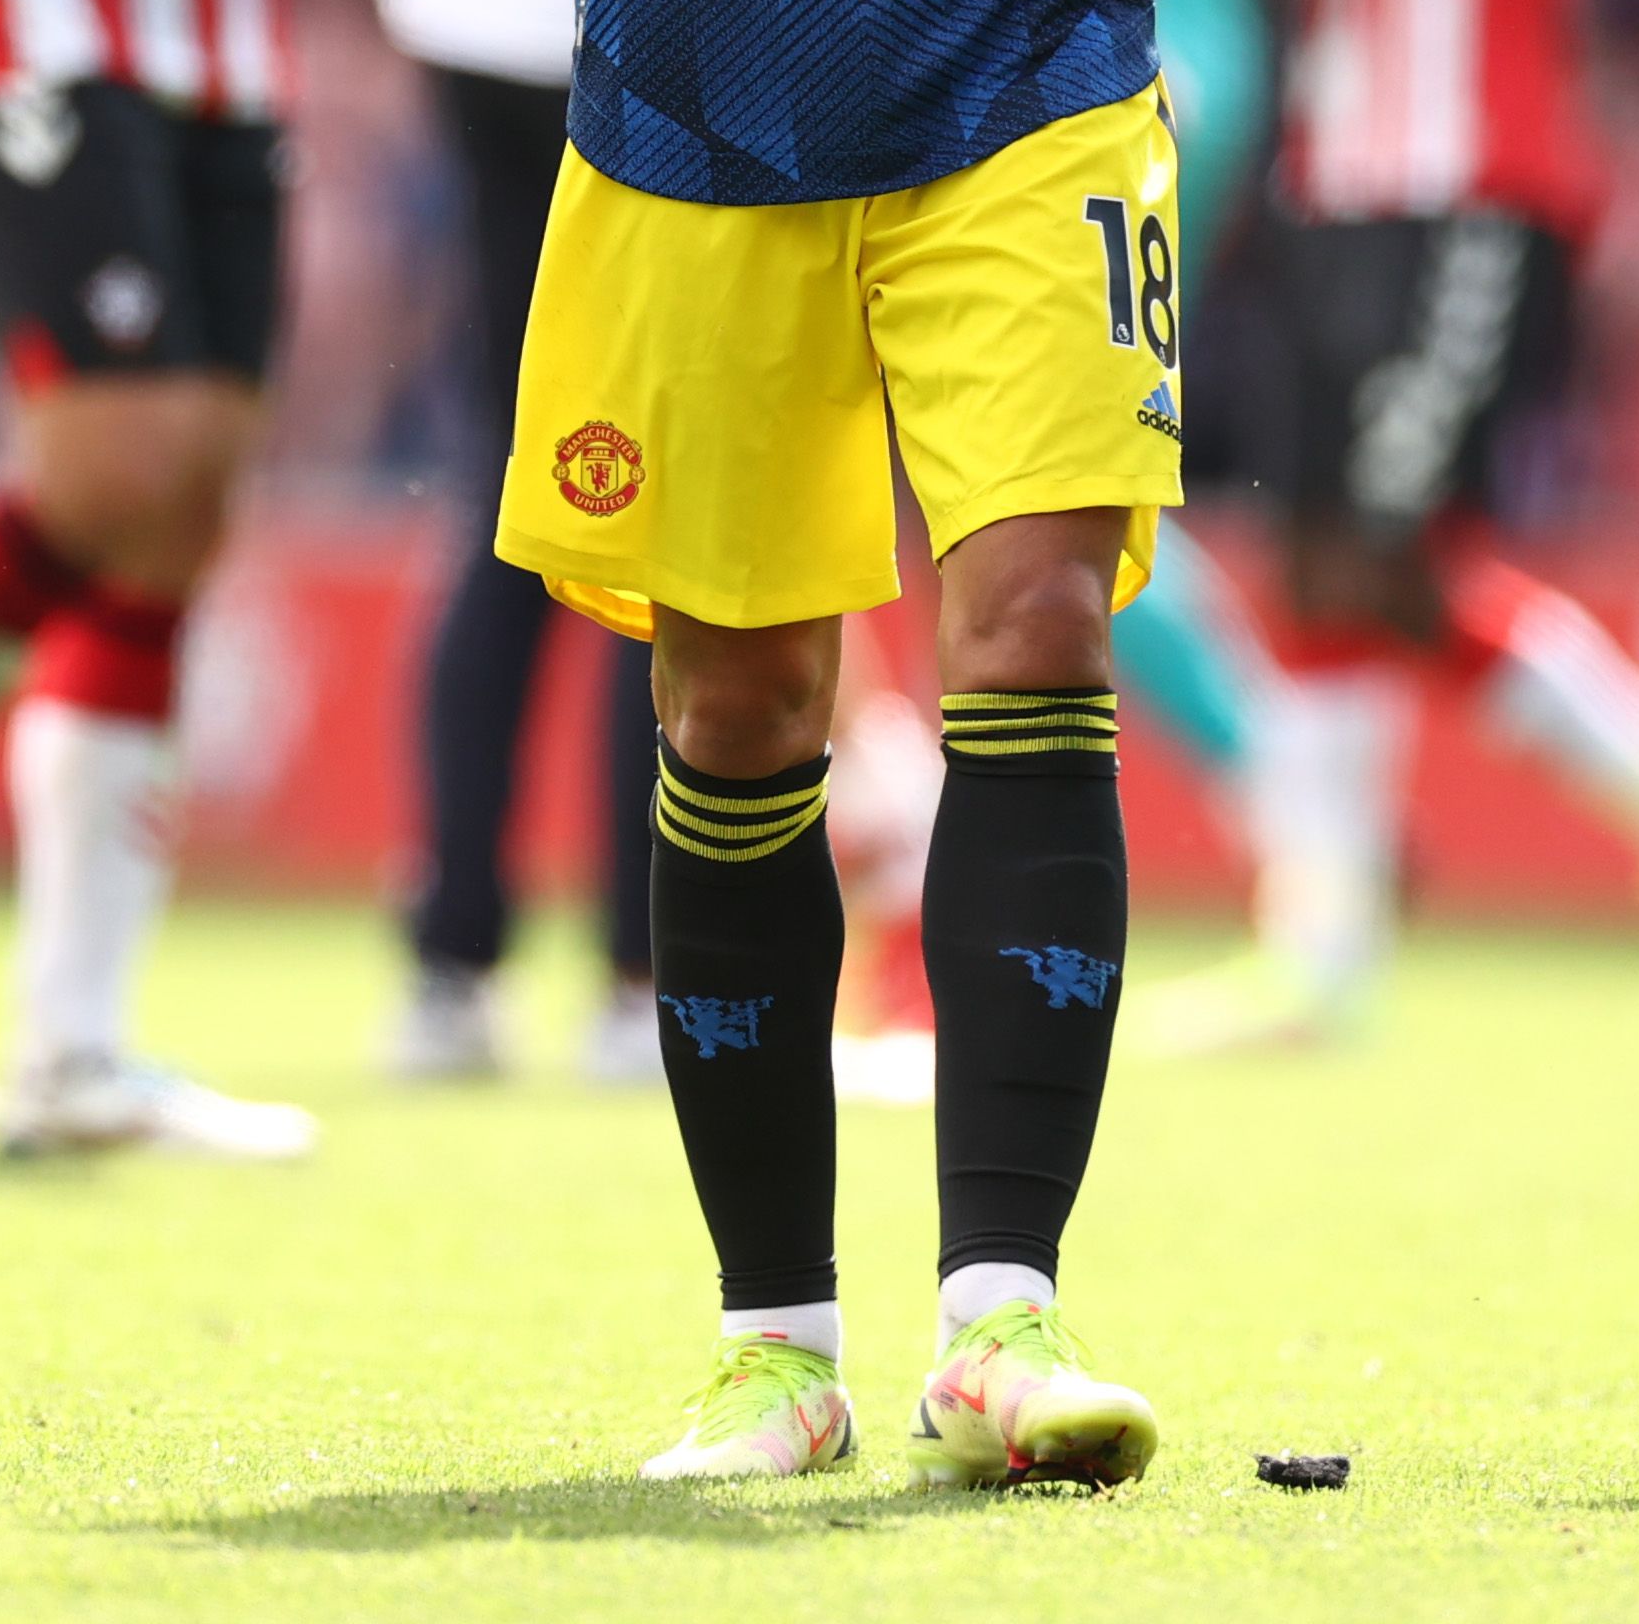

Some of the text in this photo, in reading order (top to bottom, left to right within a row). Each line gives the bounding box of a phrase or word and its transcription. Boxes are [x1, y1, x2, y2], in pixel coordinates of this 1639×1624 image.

[1083, 195, 1179, 371] 18
[562, 427, 636, 460] MANCHESTER
[574, 493, 626, 511] UNITED
